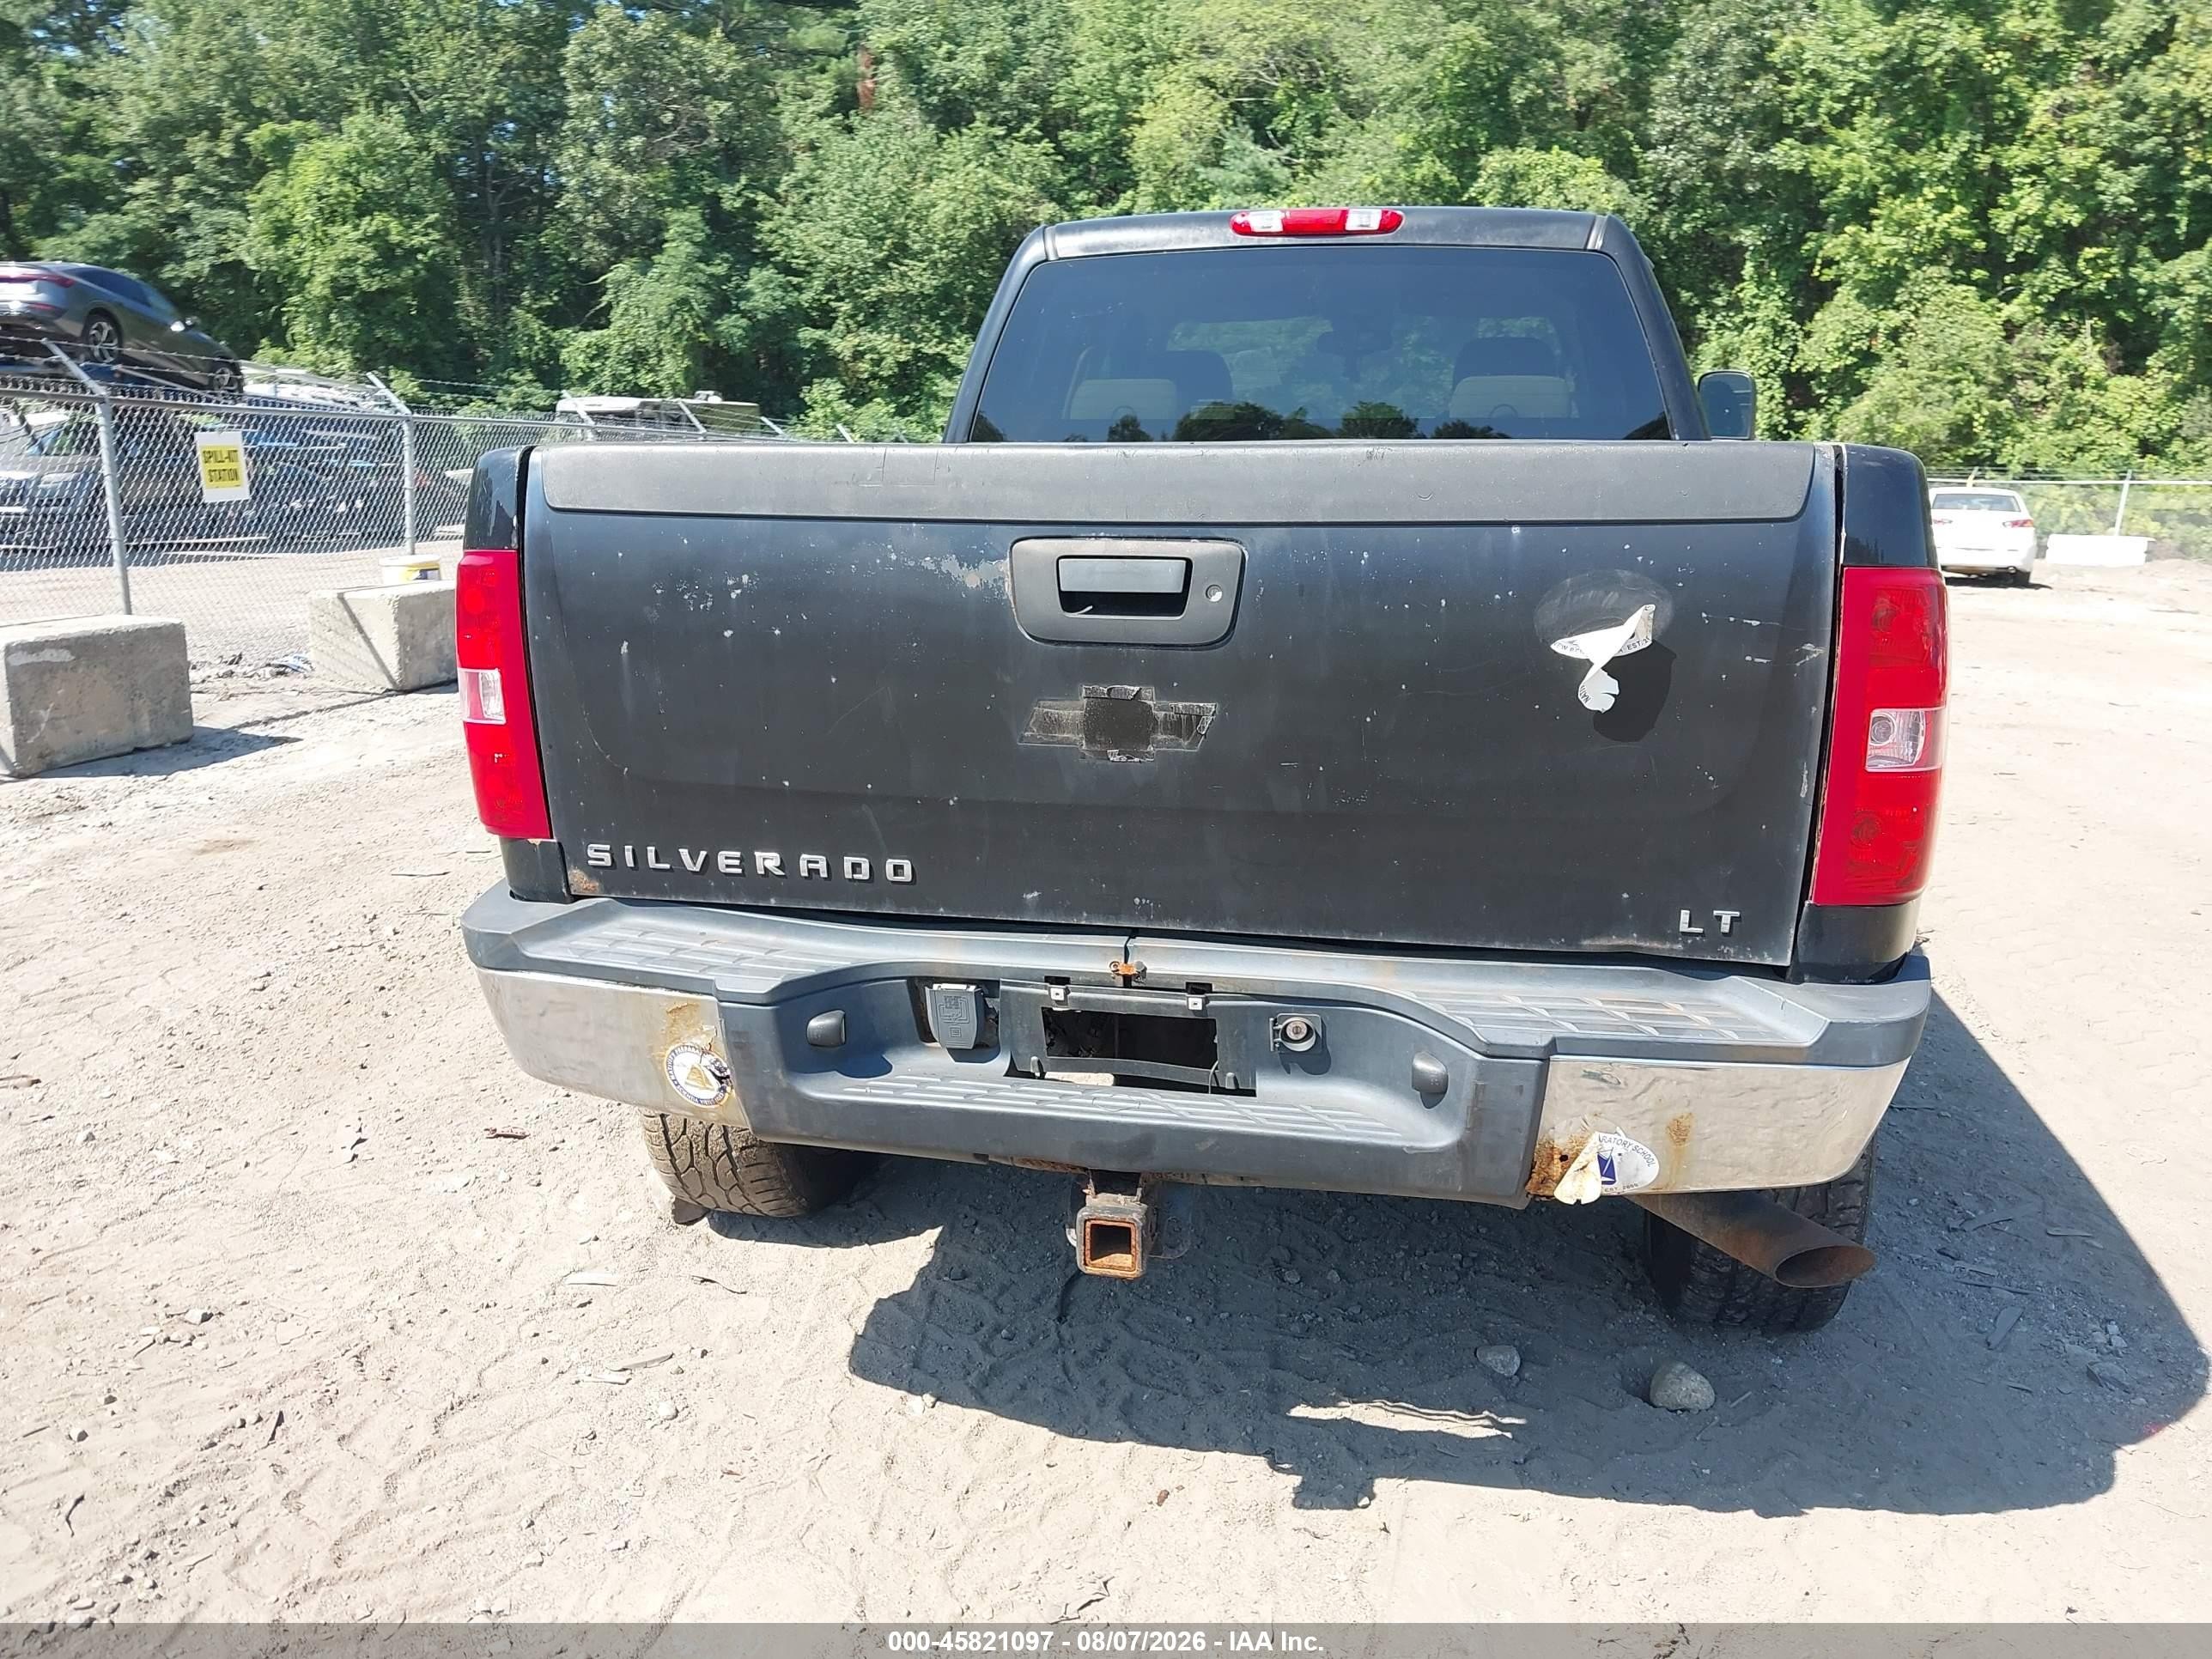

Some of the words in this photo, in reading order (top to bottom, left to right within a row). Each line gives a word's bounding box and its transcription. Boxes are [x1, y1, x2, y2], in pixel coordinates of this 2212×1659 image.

[208, 468, 240, 483] STATION
[586, 843, 914, 883] SILVERADO
[1679, 908, 1741, 934] LT
[1632, 1145, 1656, 1168] SCHOOL
